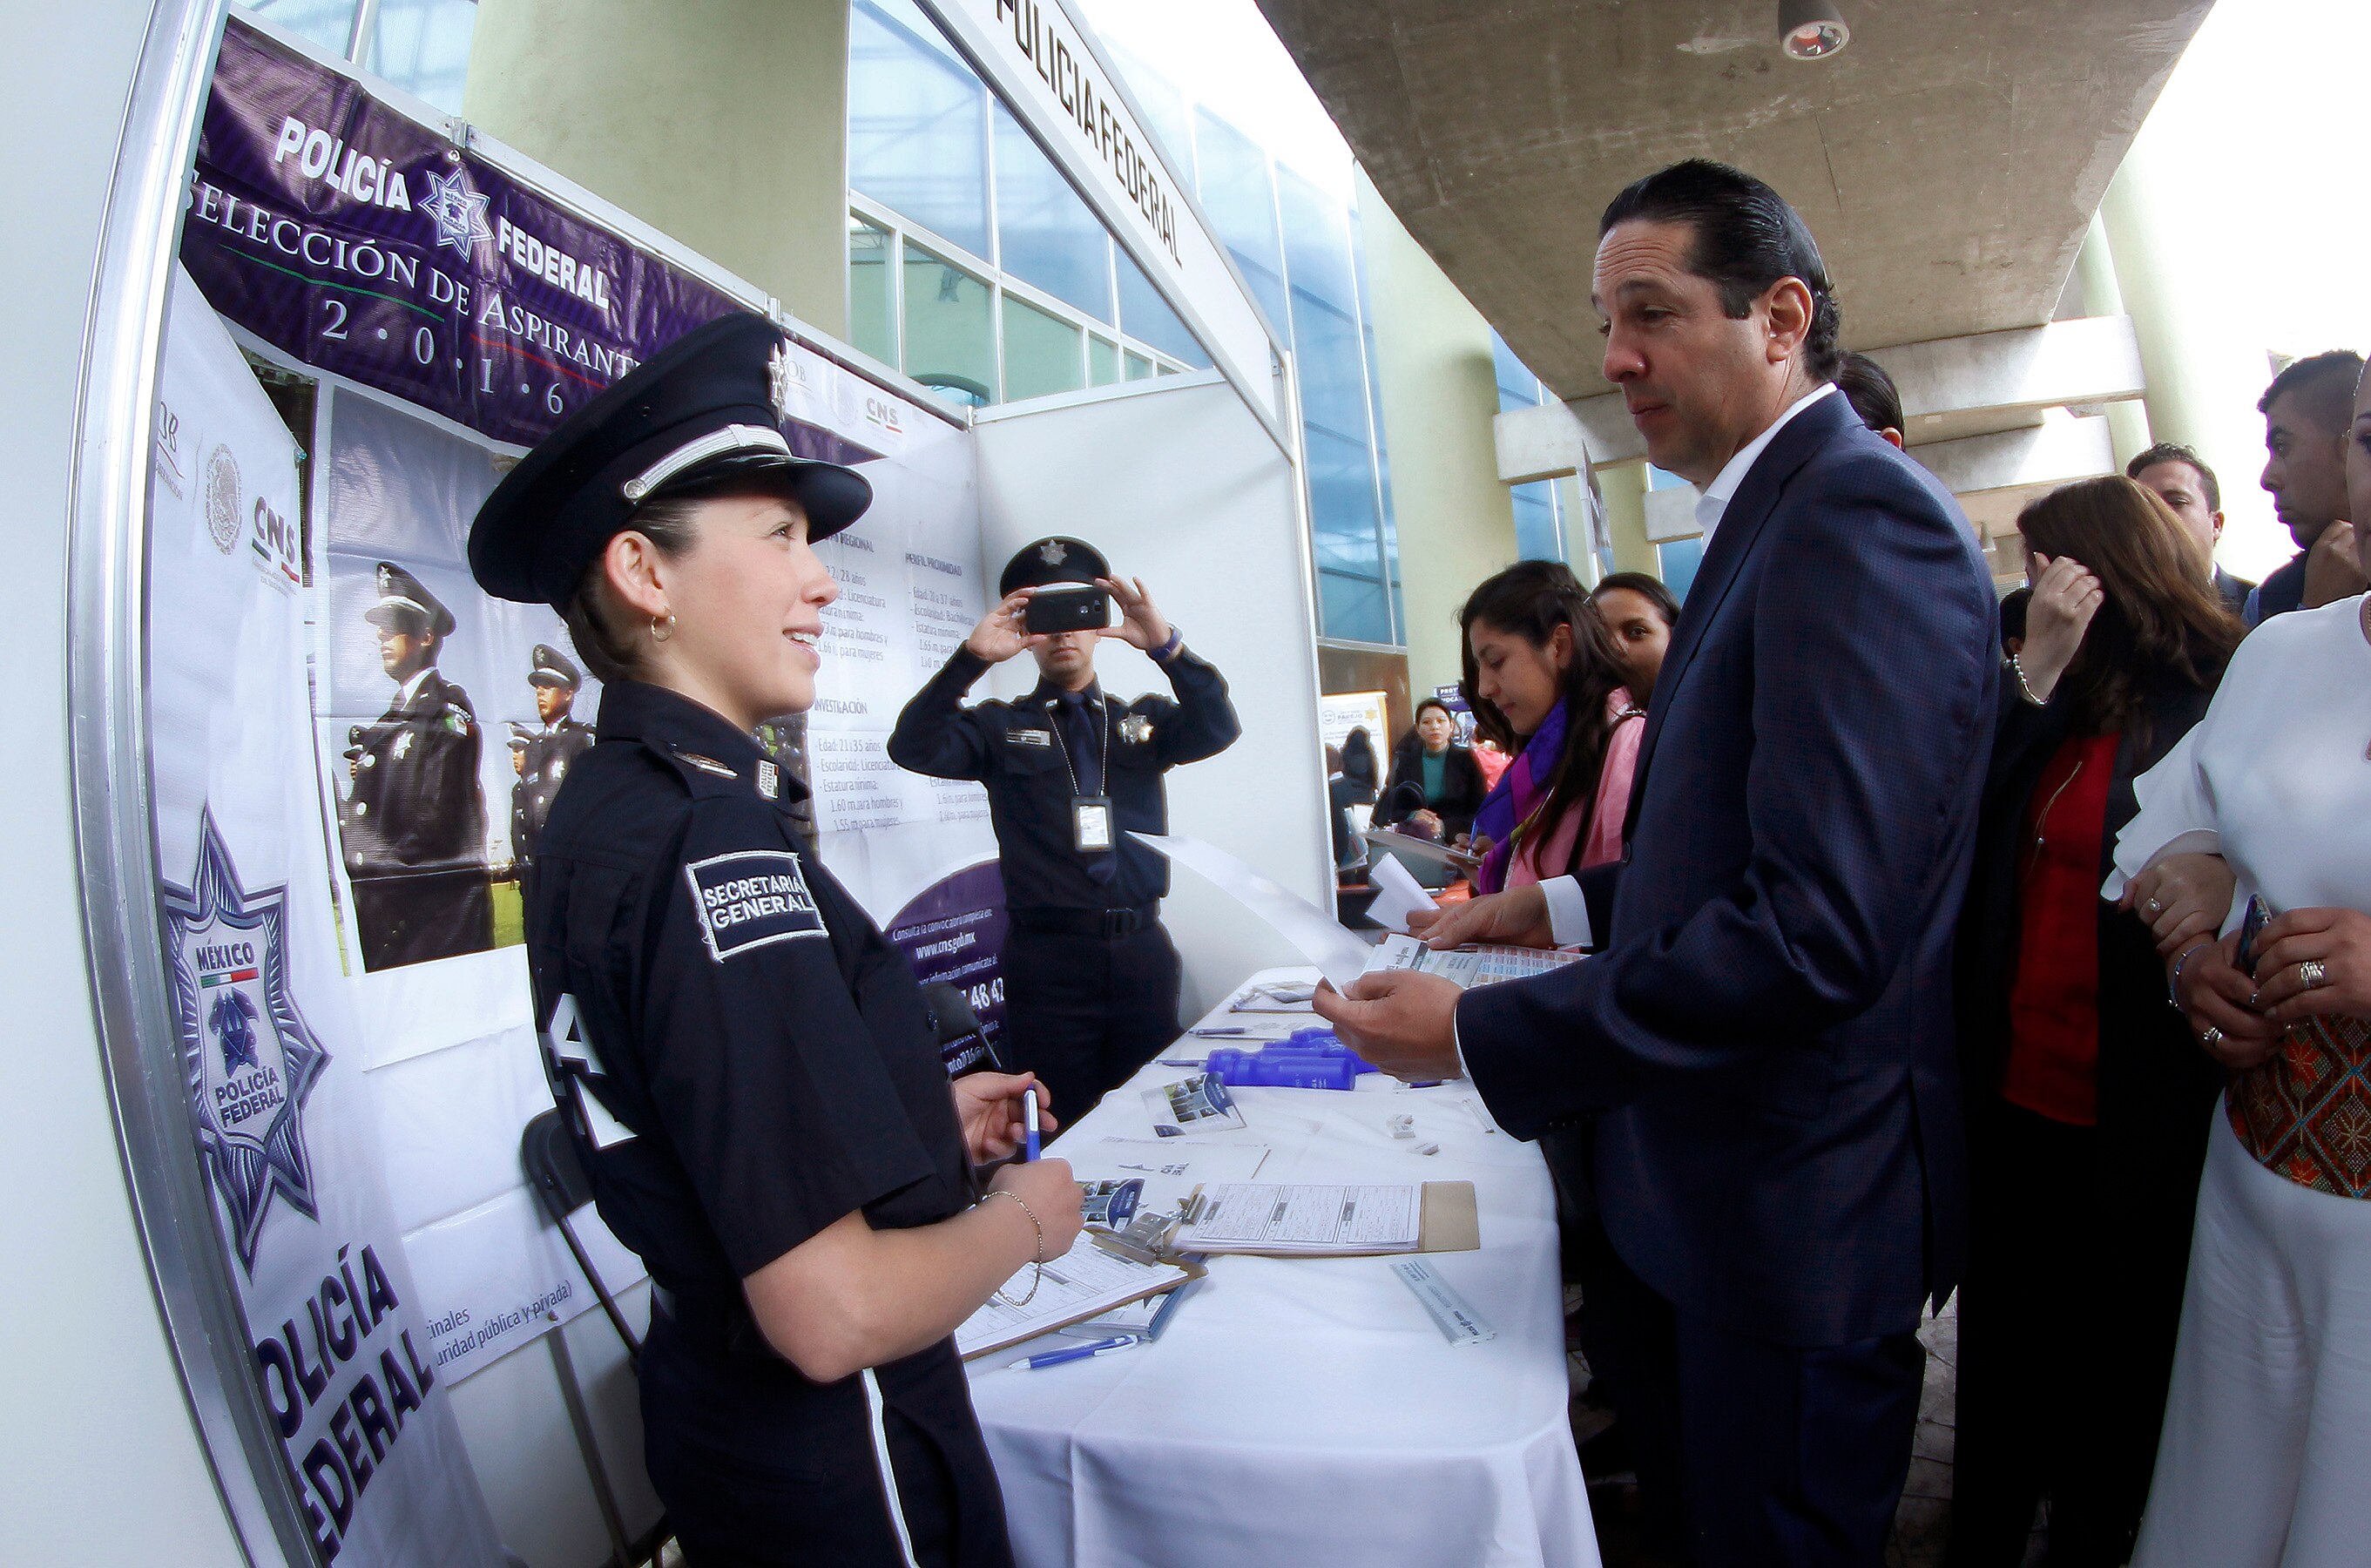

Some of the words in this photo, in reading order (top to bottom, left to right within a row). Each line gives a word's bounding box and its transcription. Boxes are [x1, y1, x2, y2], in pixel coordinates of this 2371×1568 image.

[274, 115, 412, 213] POLICÍA
[1100, 97, 1183, 270] FEDERAL
[497, 214, 611, 311] FEDERAL
[429, 267, 470, 316] DE
[478, 293, 642, 381] ASPIRANT
[867, 396, 900, 426] CNS
[253, 496, 296, 564] CNS
[703, 874, 806, 908] SECRETARIA
[710, 893, 815, 929] GENERAL
[196, 936, 256, 971] MÉXICO
[215, 1064, 280, 1106] POLICÍA
[220, 1087, 287, 1129] FEDERAL
[256, 1242, 400, 1439] OLICÍA
[477, 1309, 521, 1349] pública
[532, 1280, 573, 1320] privada)
[302, 1328, 436, 1566] EDERAL
